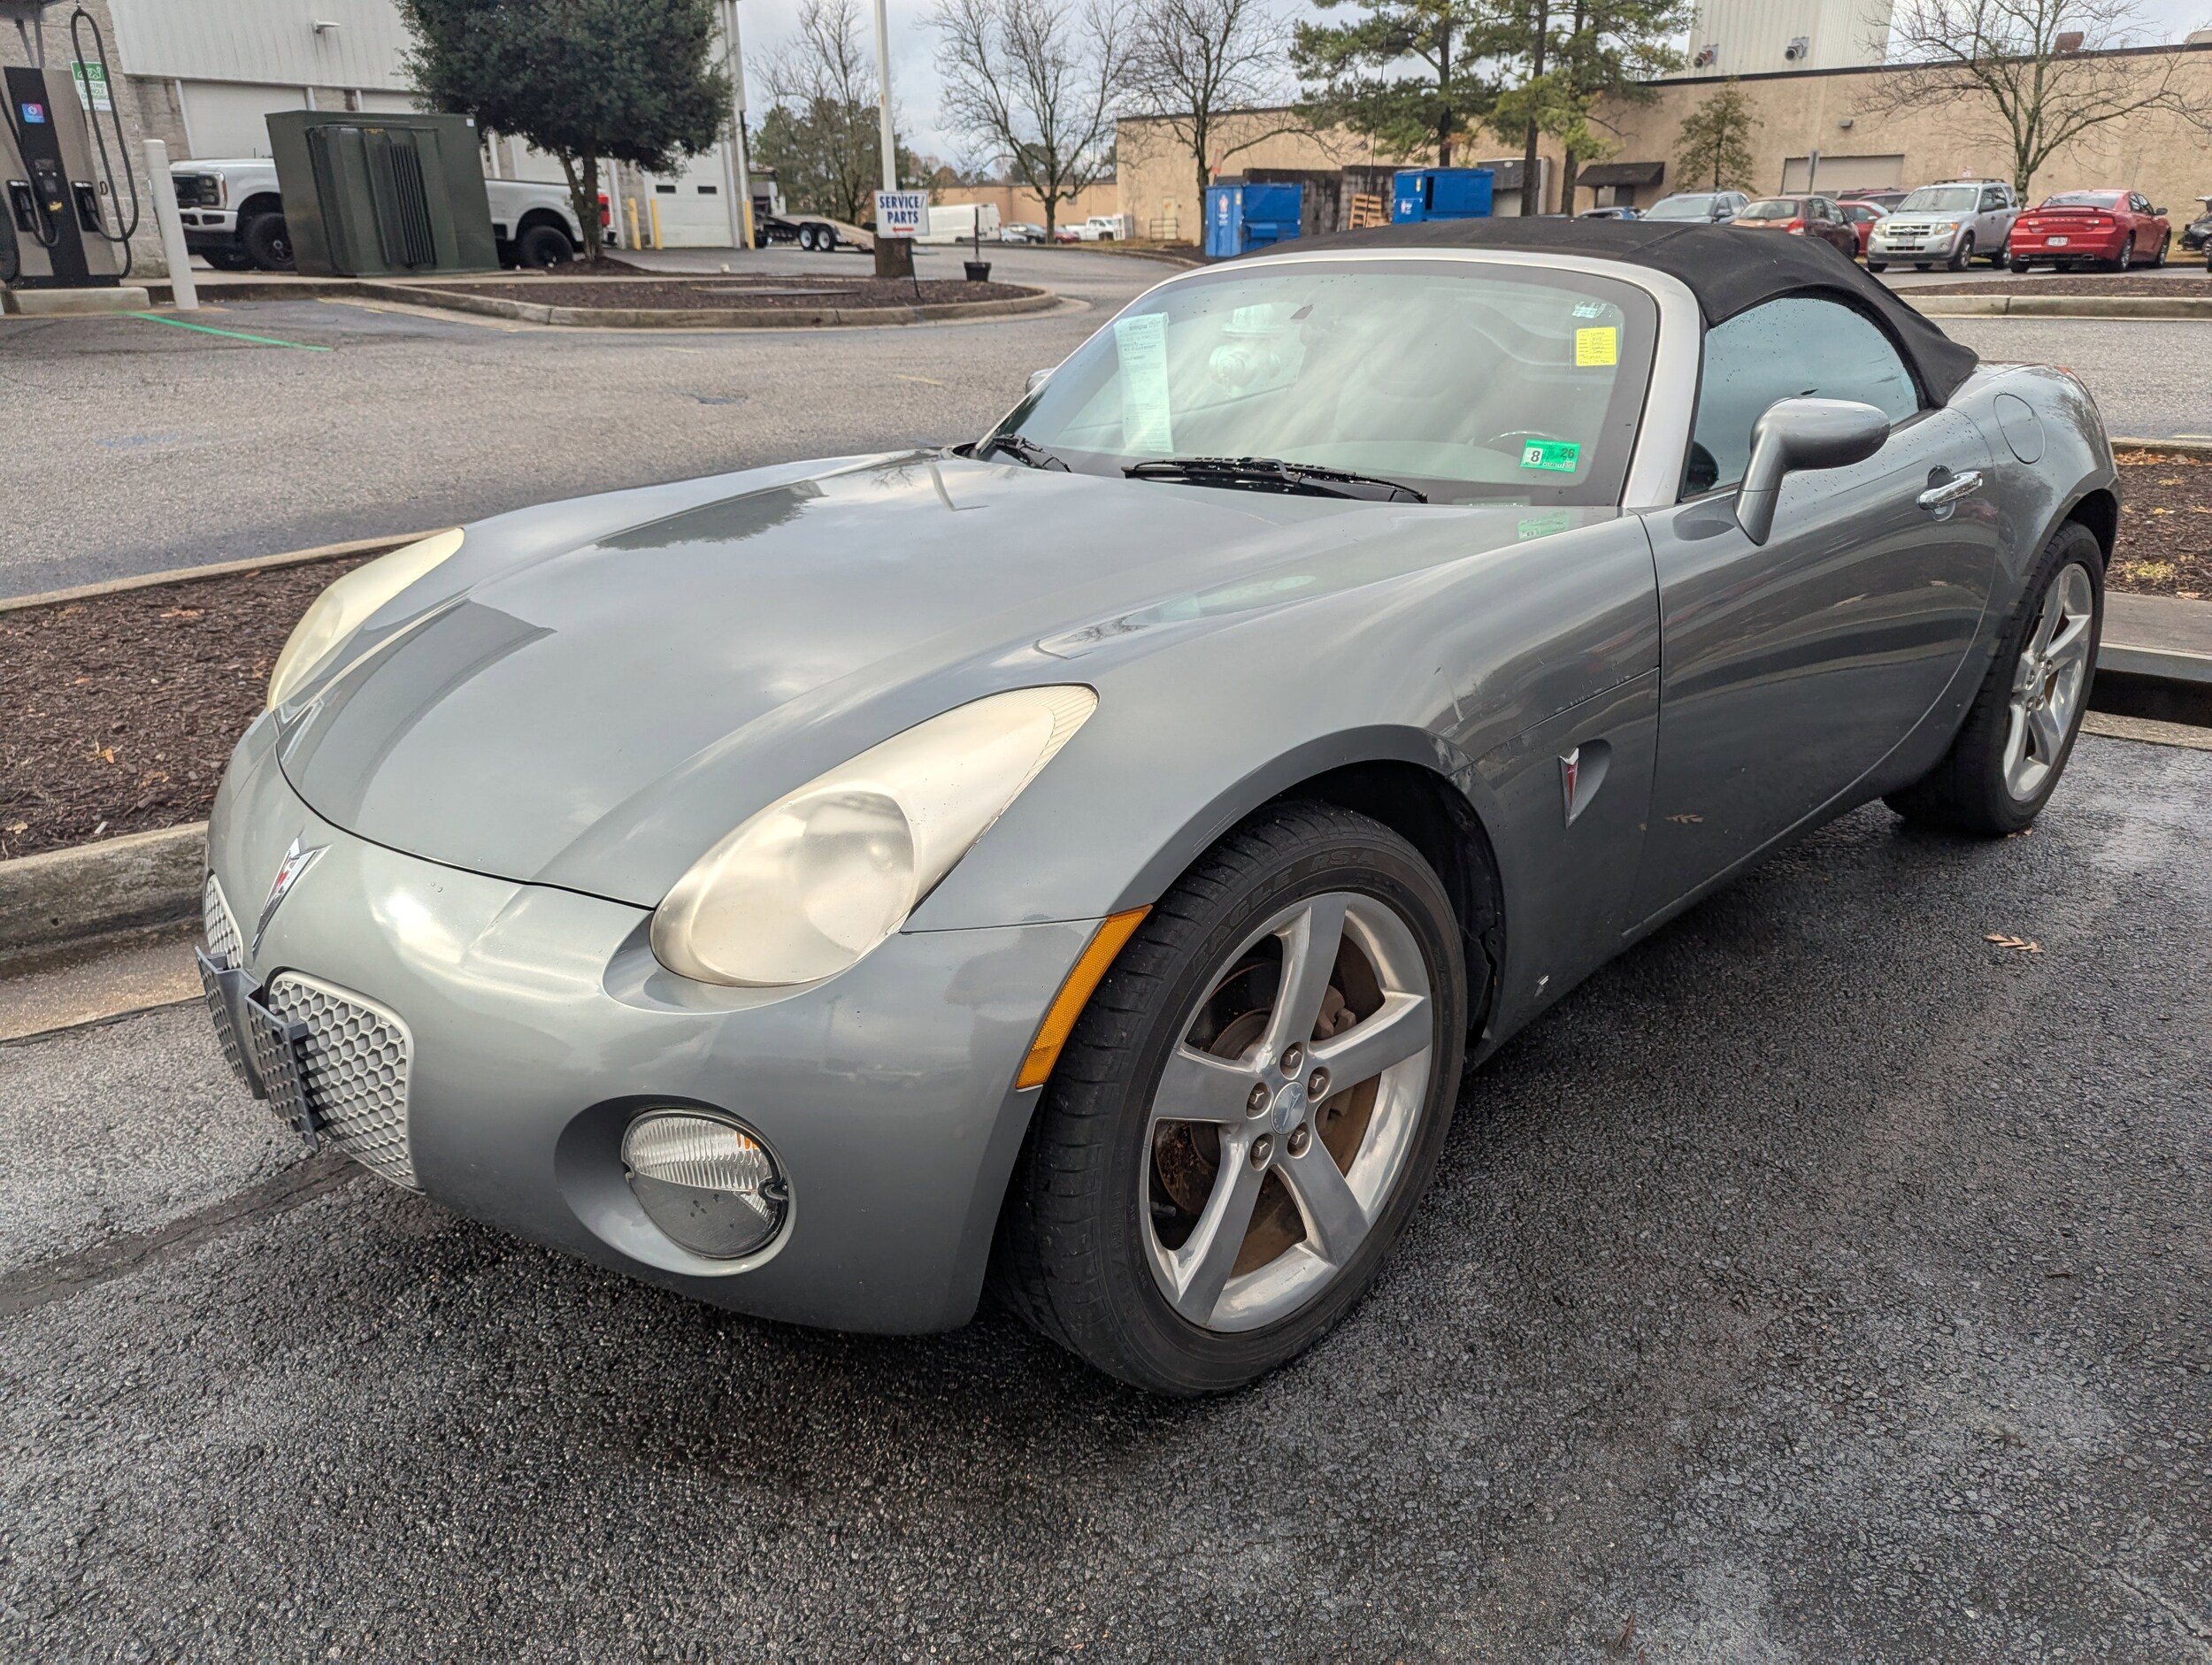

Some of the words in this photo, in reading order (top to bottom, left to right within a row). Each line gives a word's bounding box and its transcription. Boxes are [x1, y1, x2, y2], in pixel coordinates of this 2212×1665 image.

[879, 196, 925, 209] SERVICE/
[887, 211, 919, 224] PARTS
[1531, 450, 1540, 463] 8
[1560, 448, 1576, 459] 26
[1191, 867, 1293, 977] EAGLE
